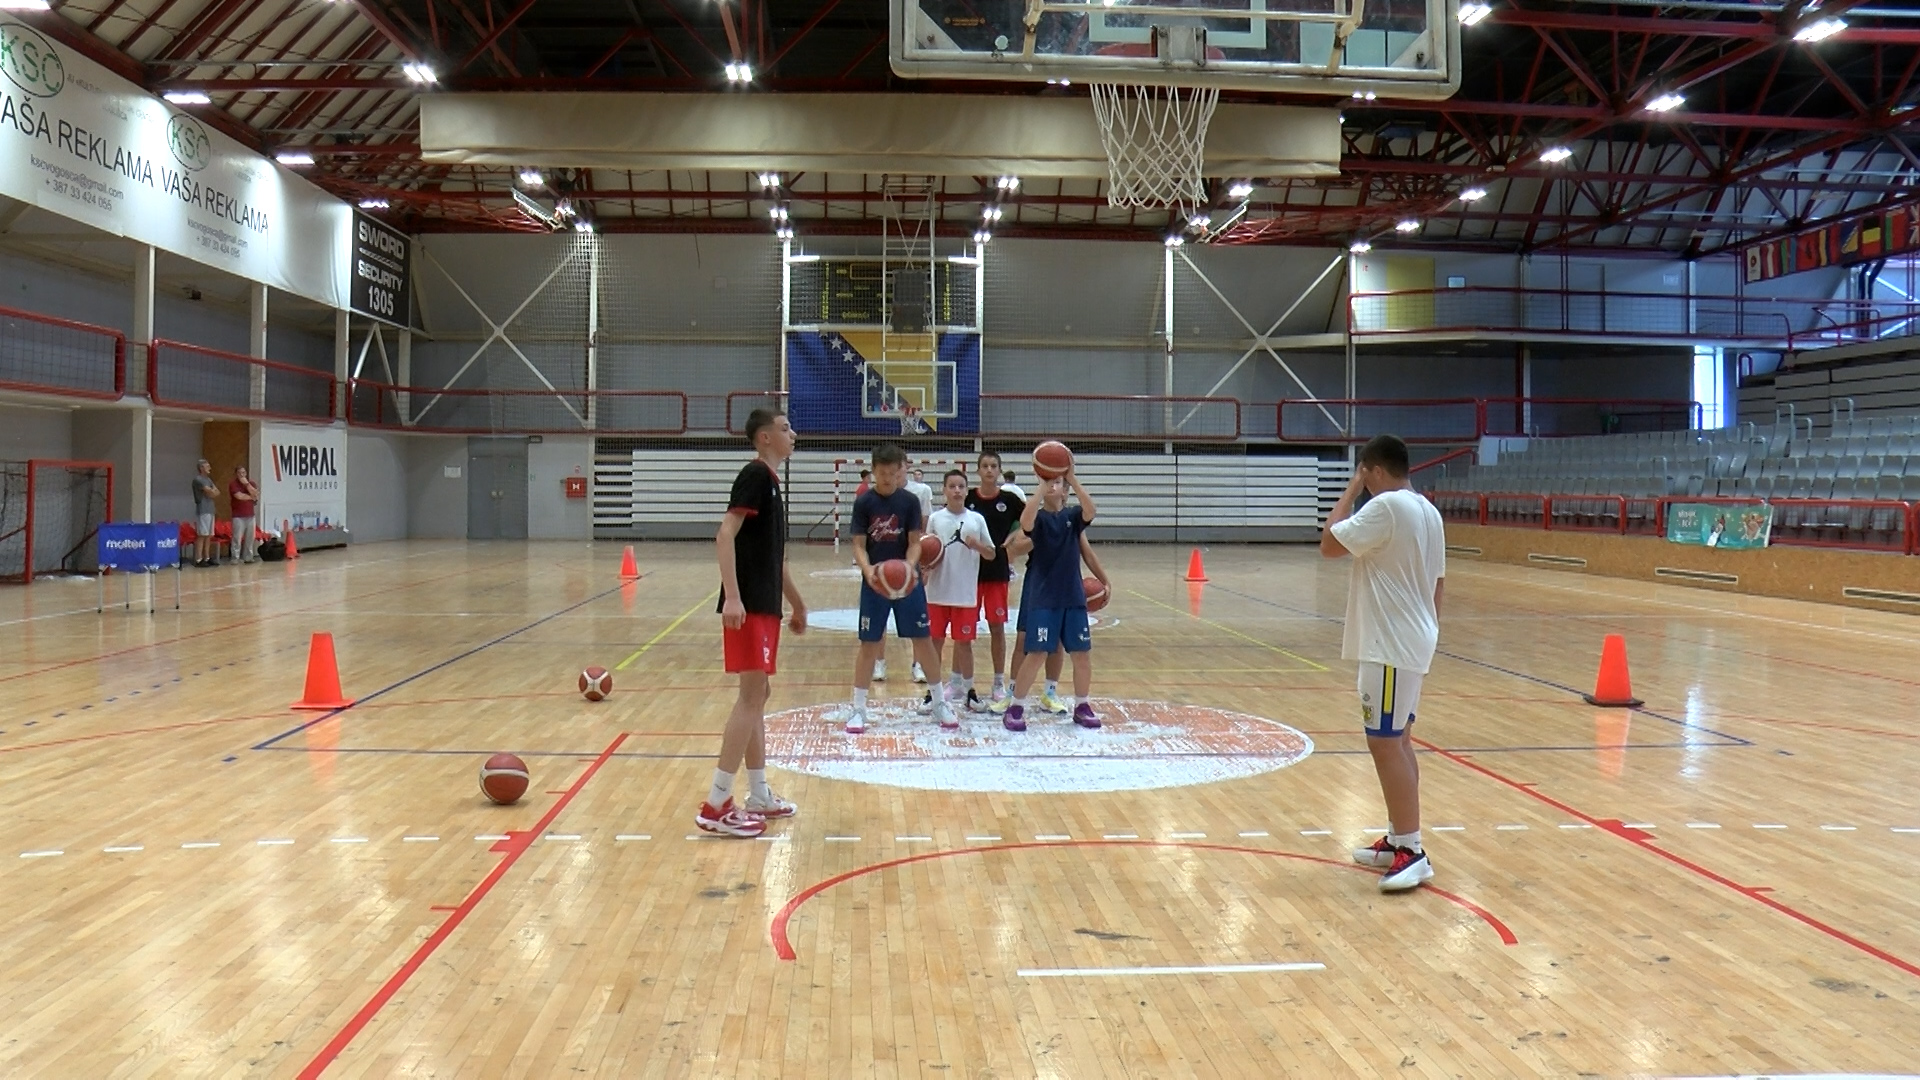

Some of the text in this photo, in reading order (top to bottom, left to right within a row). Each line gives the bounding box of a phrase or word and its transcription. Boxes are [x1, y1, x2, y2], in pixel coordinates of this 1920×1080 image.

[0, 27, 60, 92] KSC
[0, 91, 154, 187] AŠA REKLAMA
[161, 166, 268, 233] VAŠA REKLAMA
[359, 220, 404, 260] SWORD
[358, 259, 403, 291] SECURITY
[368, 285, 394, 316] 1305
[279, 445, 337, 476] MIBRAL
[298, 481, 338, 490] SARAJEVO
